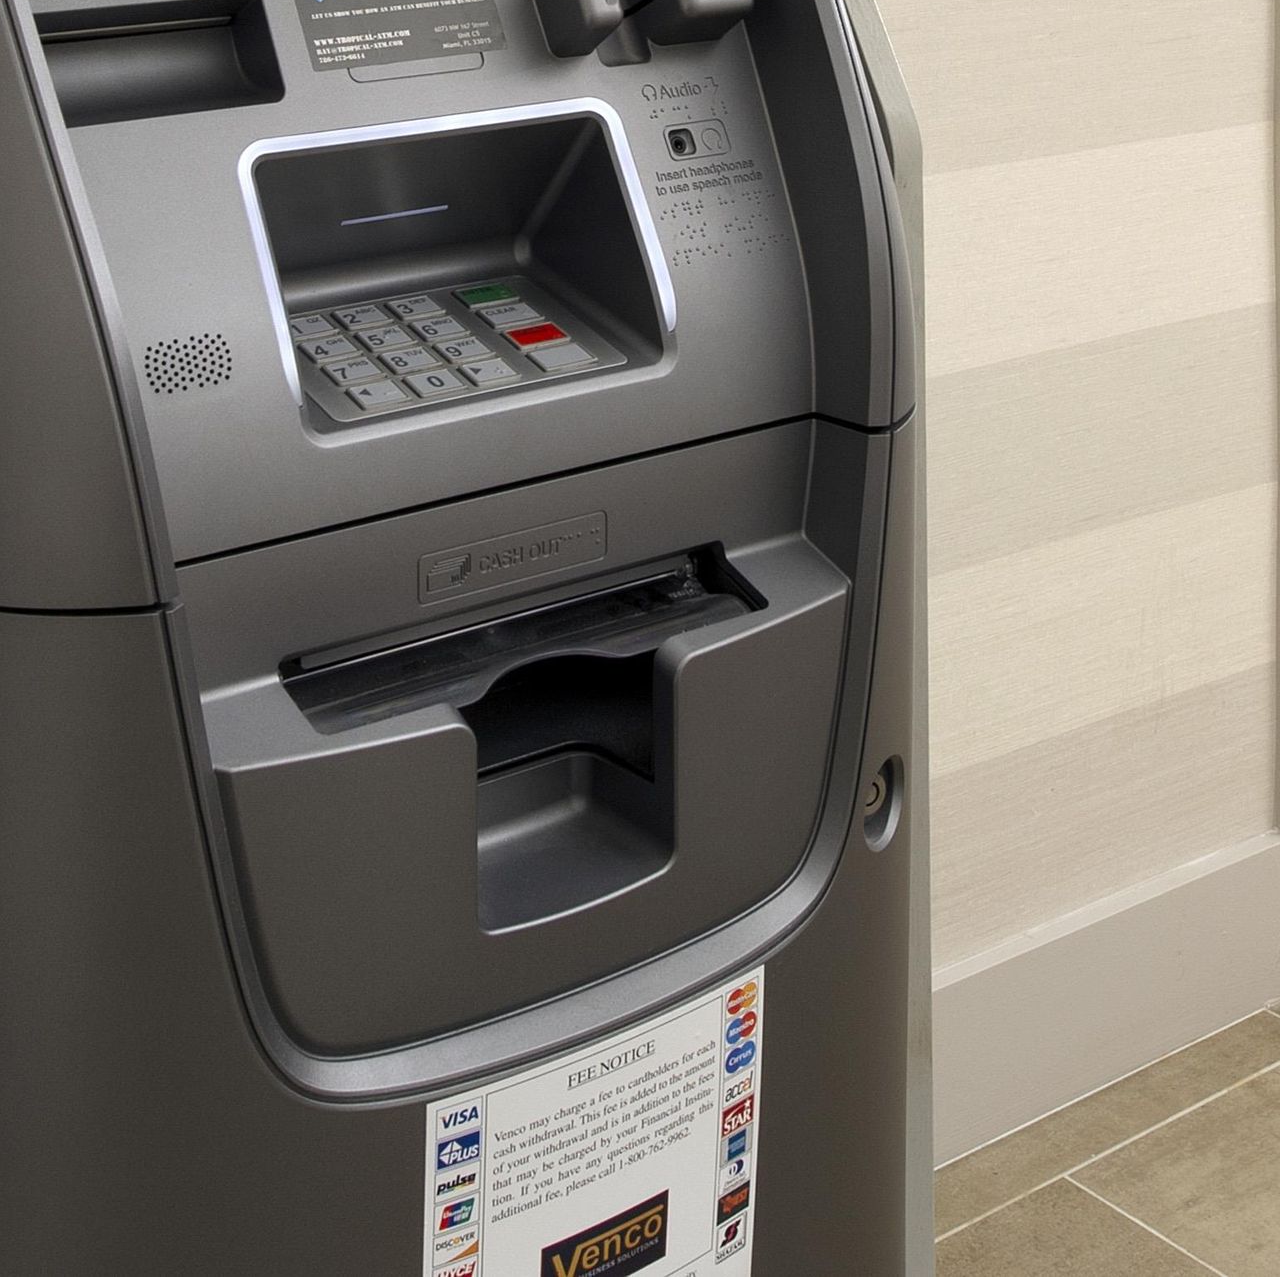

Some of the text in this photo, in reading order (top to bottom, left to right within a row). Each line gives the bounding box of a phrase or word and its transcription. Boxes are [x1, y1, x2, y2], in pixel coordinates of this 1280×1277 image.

[660, 82, 702, 100] Audio
[656, 159, 755, 183] Insert headphones
[656, 170, 763, 196] to use speech mode
[343, 313, 362, 324] 2
[396, 303, 414, 314] 3
[485, 306, 516, 316] CLEAR
[291, 324, 303, 334] 1
[422, 324, 438, 336] 6
[367, 334, 384, 346] 5
[314, 345, 329, 357] 4
[391, 349, 422, 368] 8 TUV
[445, 346, 463, 358] 9
[332, 367, 348, 379] 7
[427, 376, 445, 388] 0
[479, 537, 561, 573] CASH OUT
[729, 1018, 754, 1038] Maestro
[568, 1039, 655, 1087] FEE NOTICE
[729, 1049, 752, 1066] Cirrus
[494, 1040, 716, 1143] Venco may charge a fee to cardholders for each
[441, 1106, 479, 1130] VISA
[493, 1055, 716, 1160] cash withdrawal. This fee is added to the amount
[493, 1072, 715, 1176] of your withdrawal and is in addition to the fees
[723, 1109, 751, 1135] STAR
[492, 1088, 715, 1191] that may be charged by your Financial Institu-
[449, 1144, 479, 1165] PLUS
[491, 1101, 714, 1208] tion. If you have any questions regarding this
[437, 1173, 476, 1196] pulse
[491, 1195, 542, 1223] additional
[565, 1172, 597, 1196] please
[598, 1163, 616, 1179] call
[435, 1232, 475, 1252] DISCOVER
[552, 1204, 664, 1277] Venco
[617, 1237, 660, 1263] SOLUTIONS
